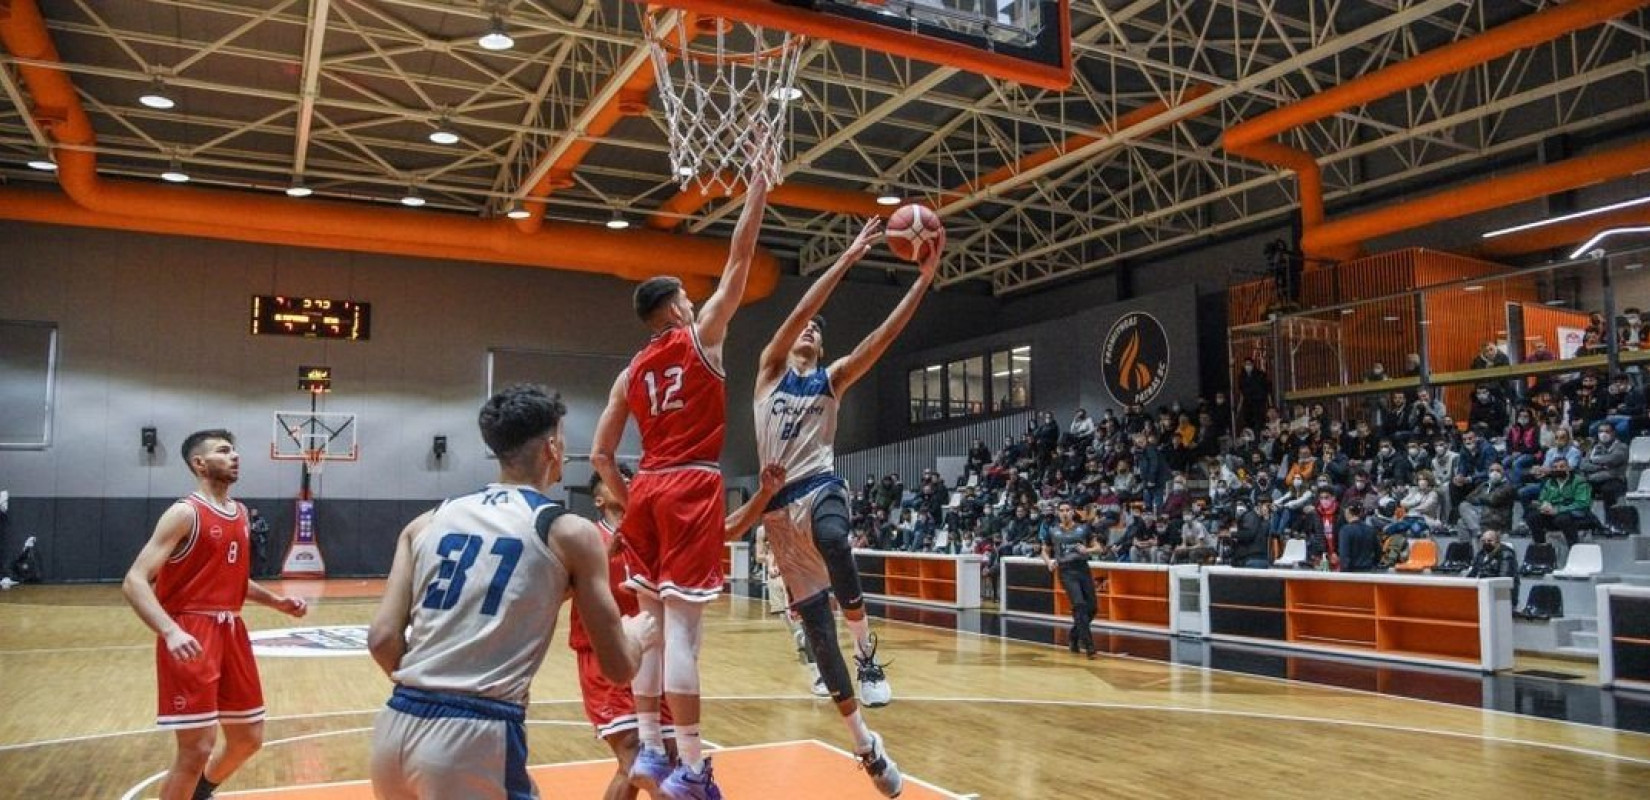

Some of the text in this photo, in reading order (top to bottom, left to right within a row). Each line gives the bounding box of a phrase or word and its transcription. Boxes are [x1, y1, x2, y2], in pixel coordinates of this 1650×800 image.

[644, 365, 685, 416] 12
[227, 541, 238, 564] 8
[421, 533, 524, 616] 31
